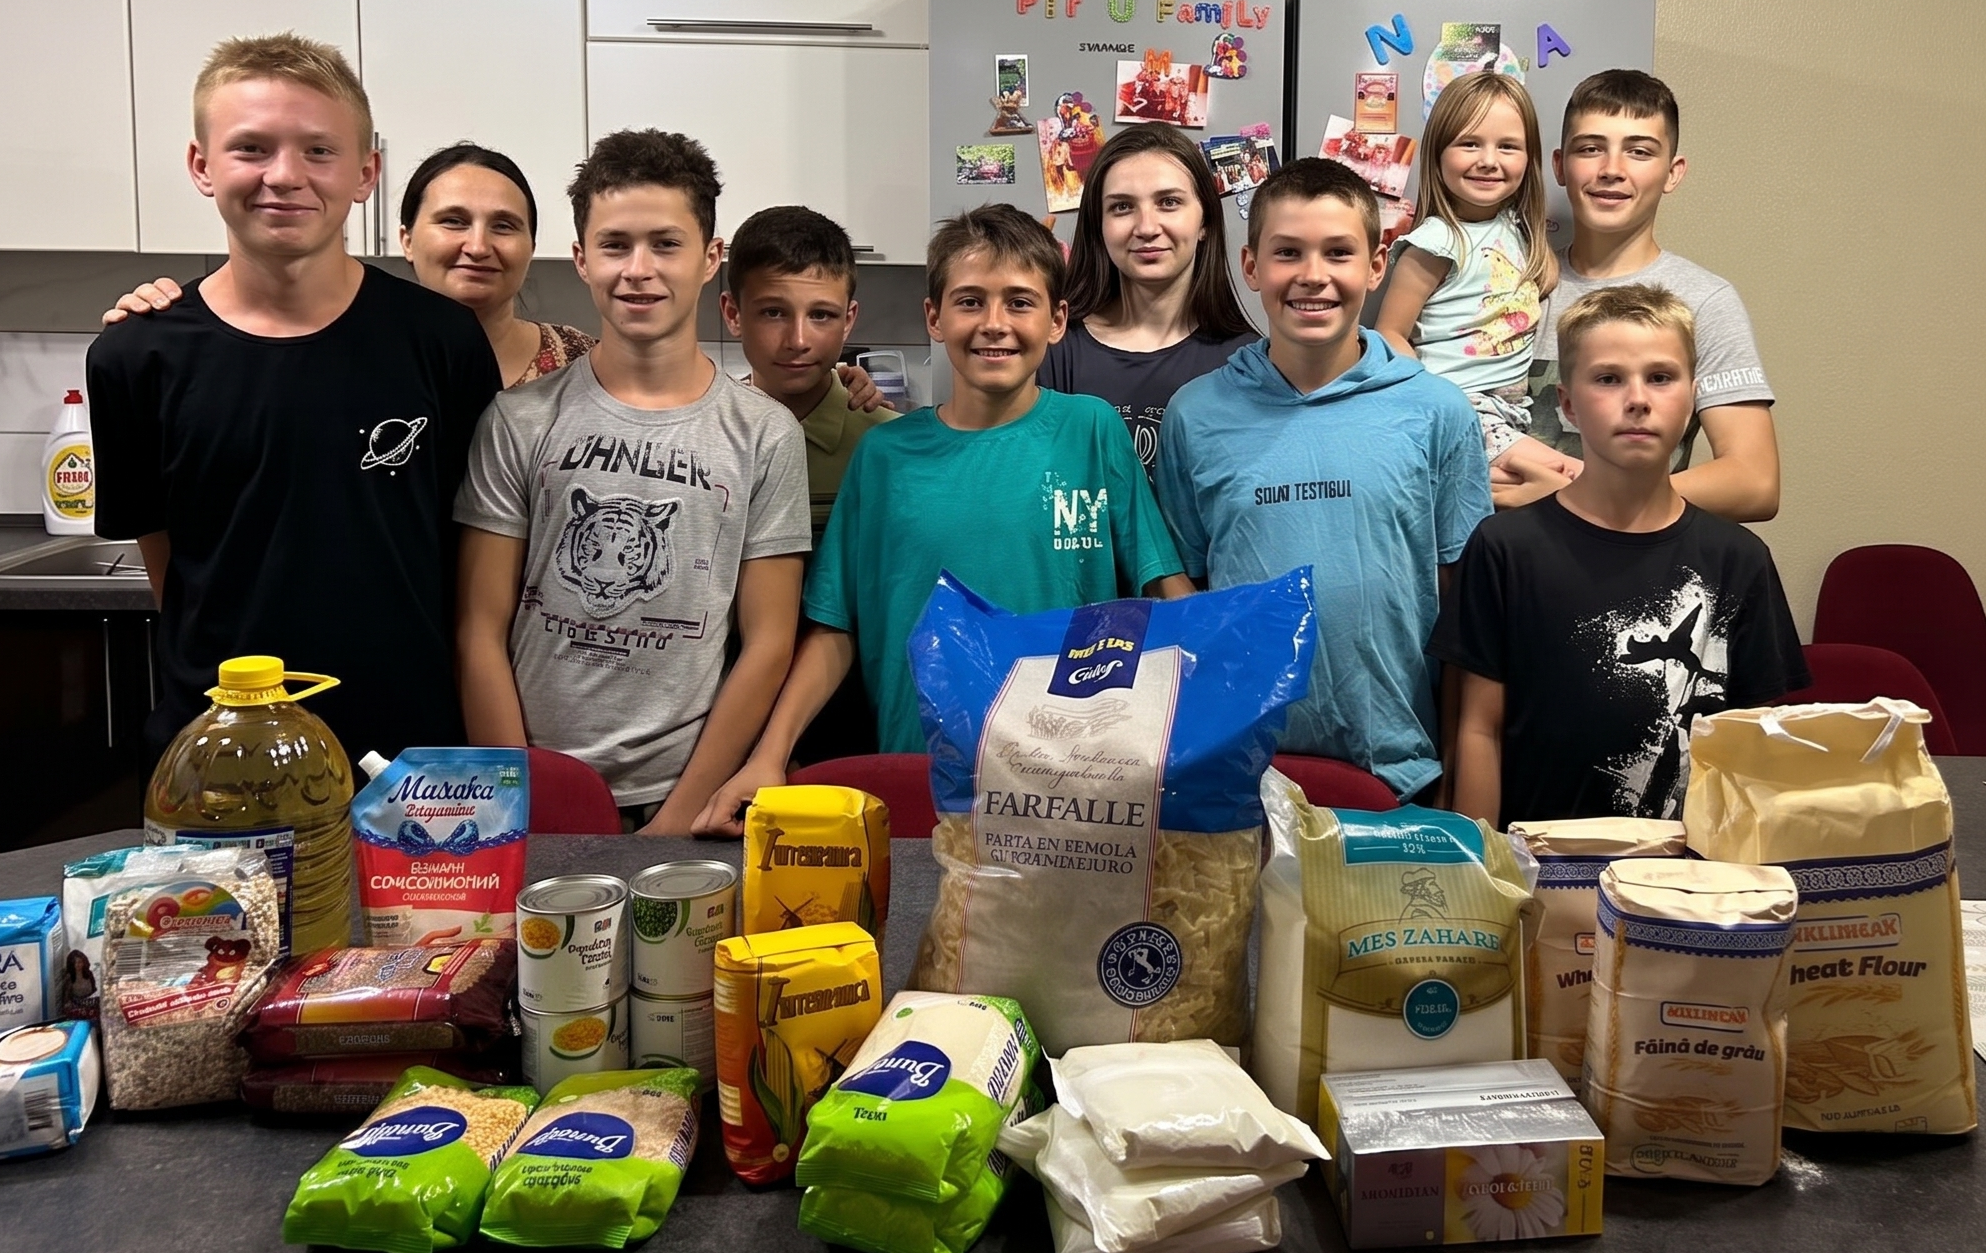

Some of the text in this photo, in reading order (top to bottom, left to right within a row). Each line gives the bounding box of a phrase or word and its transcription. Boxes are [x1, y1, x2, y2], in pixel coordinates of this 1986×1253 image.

[1365, 13, 1415, 66] N
[1537, 23, 1571, 68] A
[984, 791, 1145, 827] FARFALLE
[1347, 931, 1397, 958] MES
[1858, 956, 1927, 977] Flour
[1694, 1040, 1719, 1055] de
